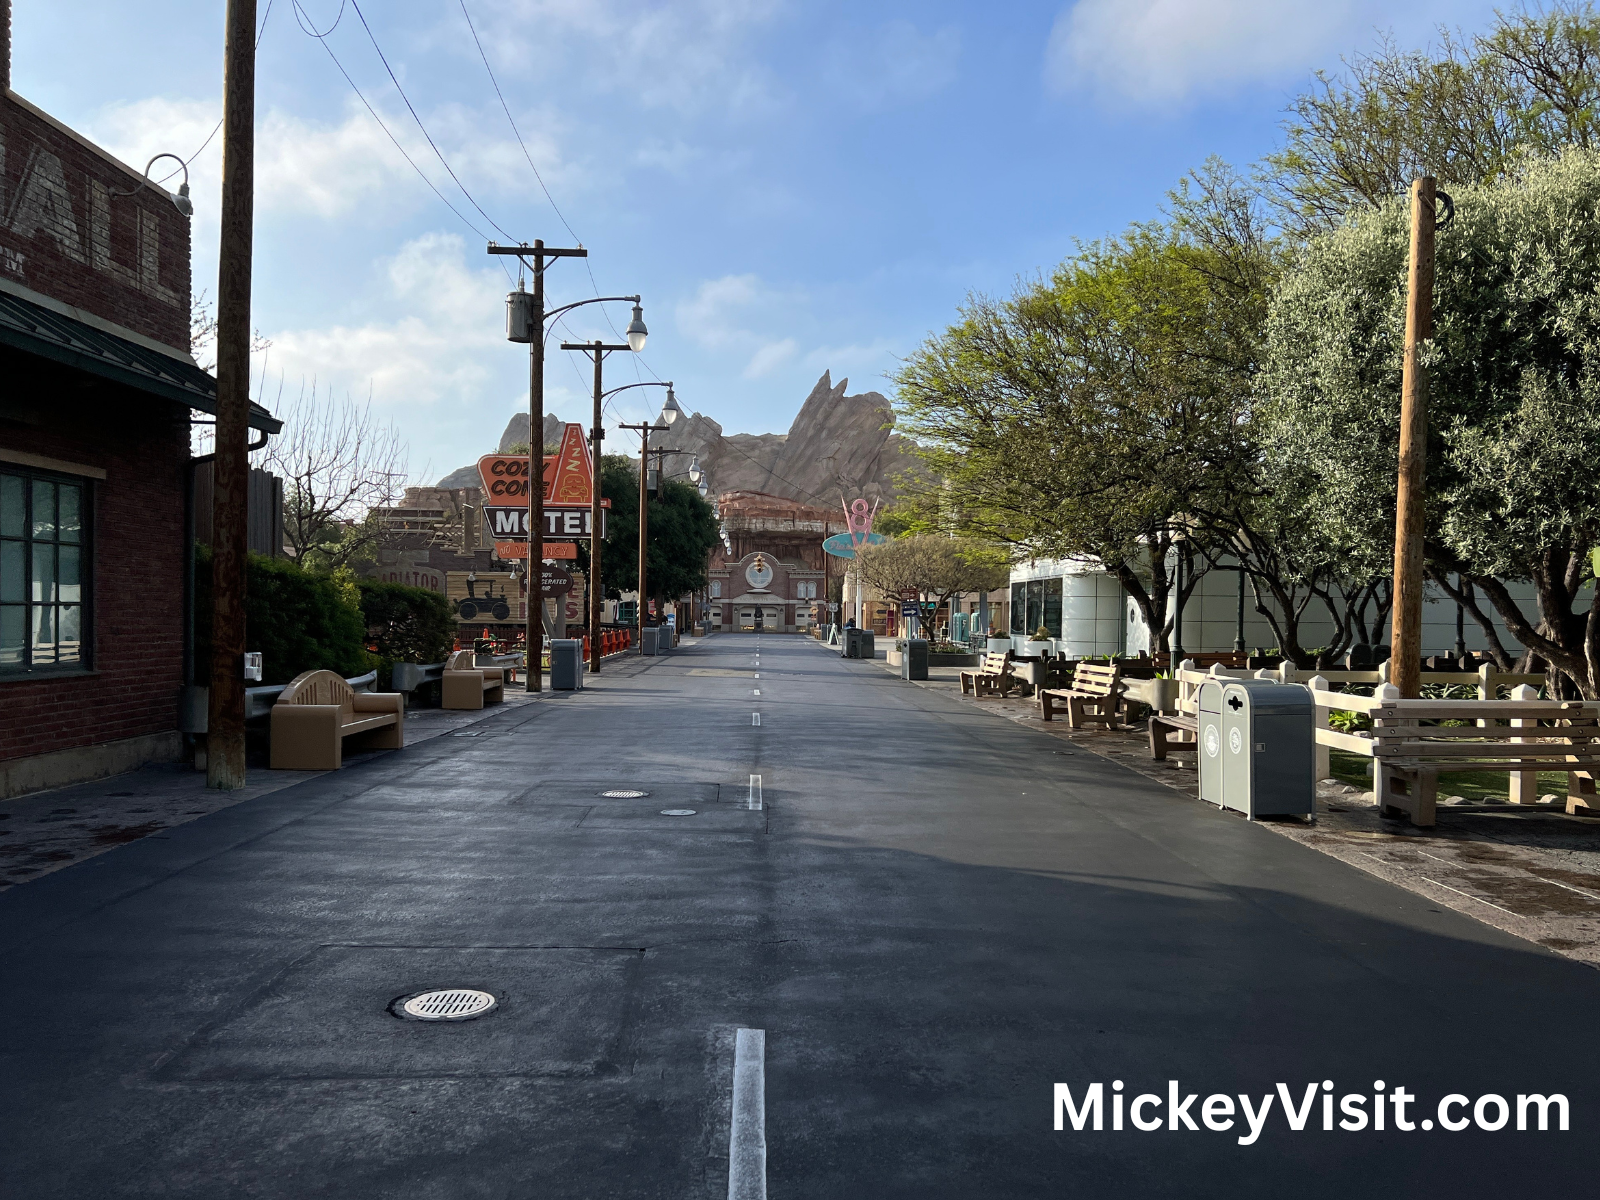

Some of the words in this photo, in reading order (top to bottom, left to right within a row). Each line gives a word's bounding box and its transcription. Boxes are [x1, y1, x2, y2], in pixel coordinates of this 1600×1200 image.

[0, 142, 181, 309] ALL
[496, 510, 592, 534] MTEL
[515, 546, 568, 556] VANCY
[369, 571, 439, 591] ADIATOR
